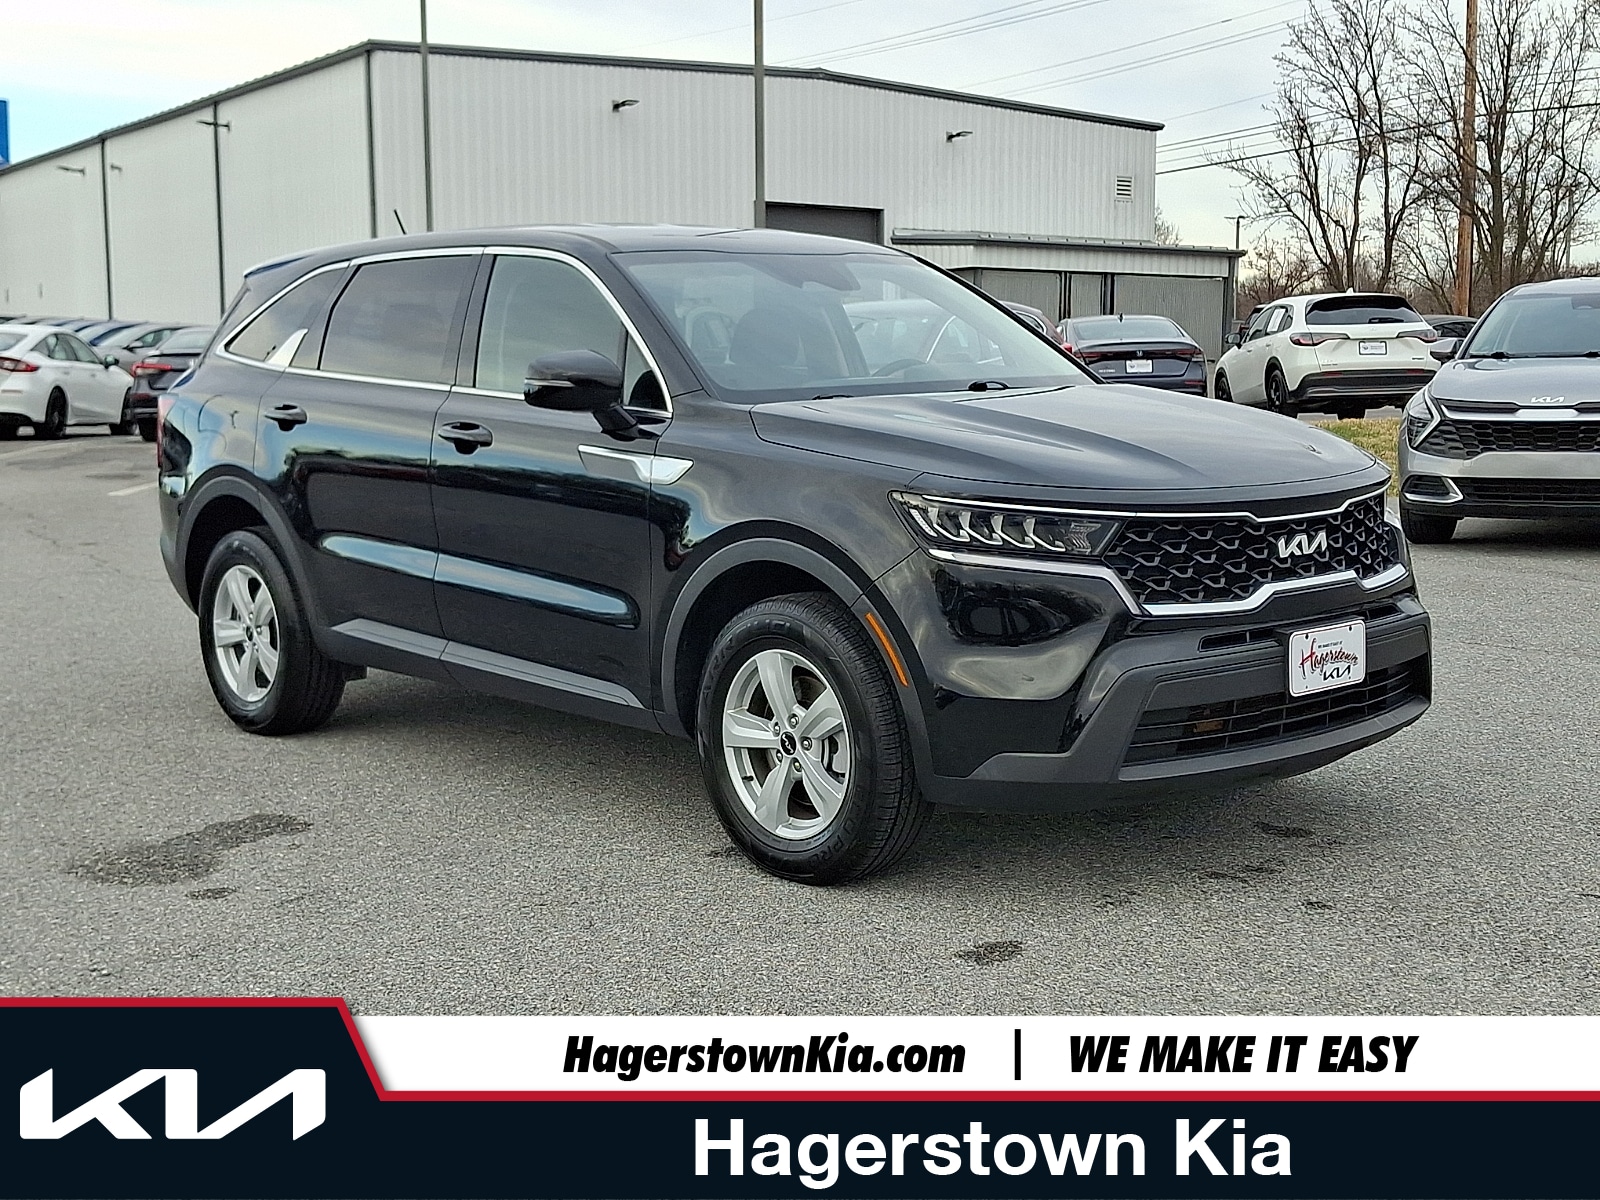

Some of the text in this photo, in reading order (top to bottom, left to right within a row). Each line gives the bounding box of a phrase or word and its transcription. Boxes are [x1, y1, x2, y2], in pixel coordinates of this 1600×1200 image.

[1277, 528, 1328, 559] KIA
[1300, 638, 1358, 679] Hagerstown
[1323, 665, 1351, 680] KIA
